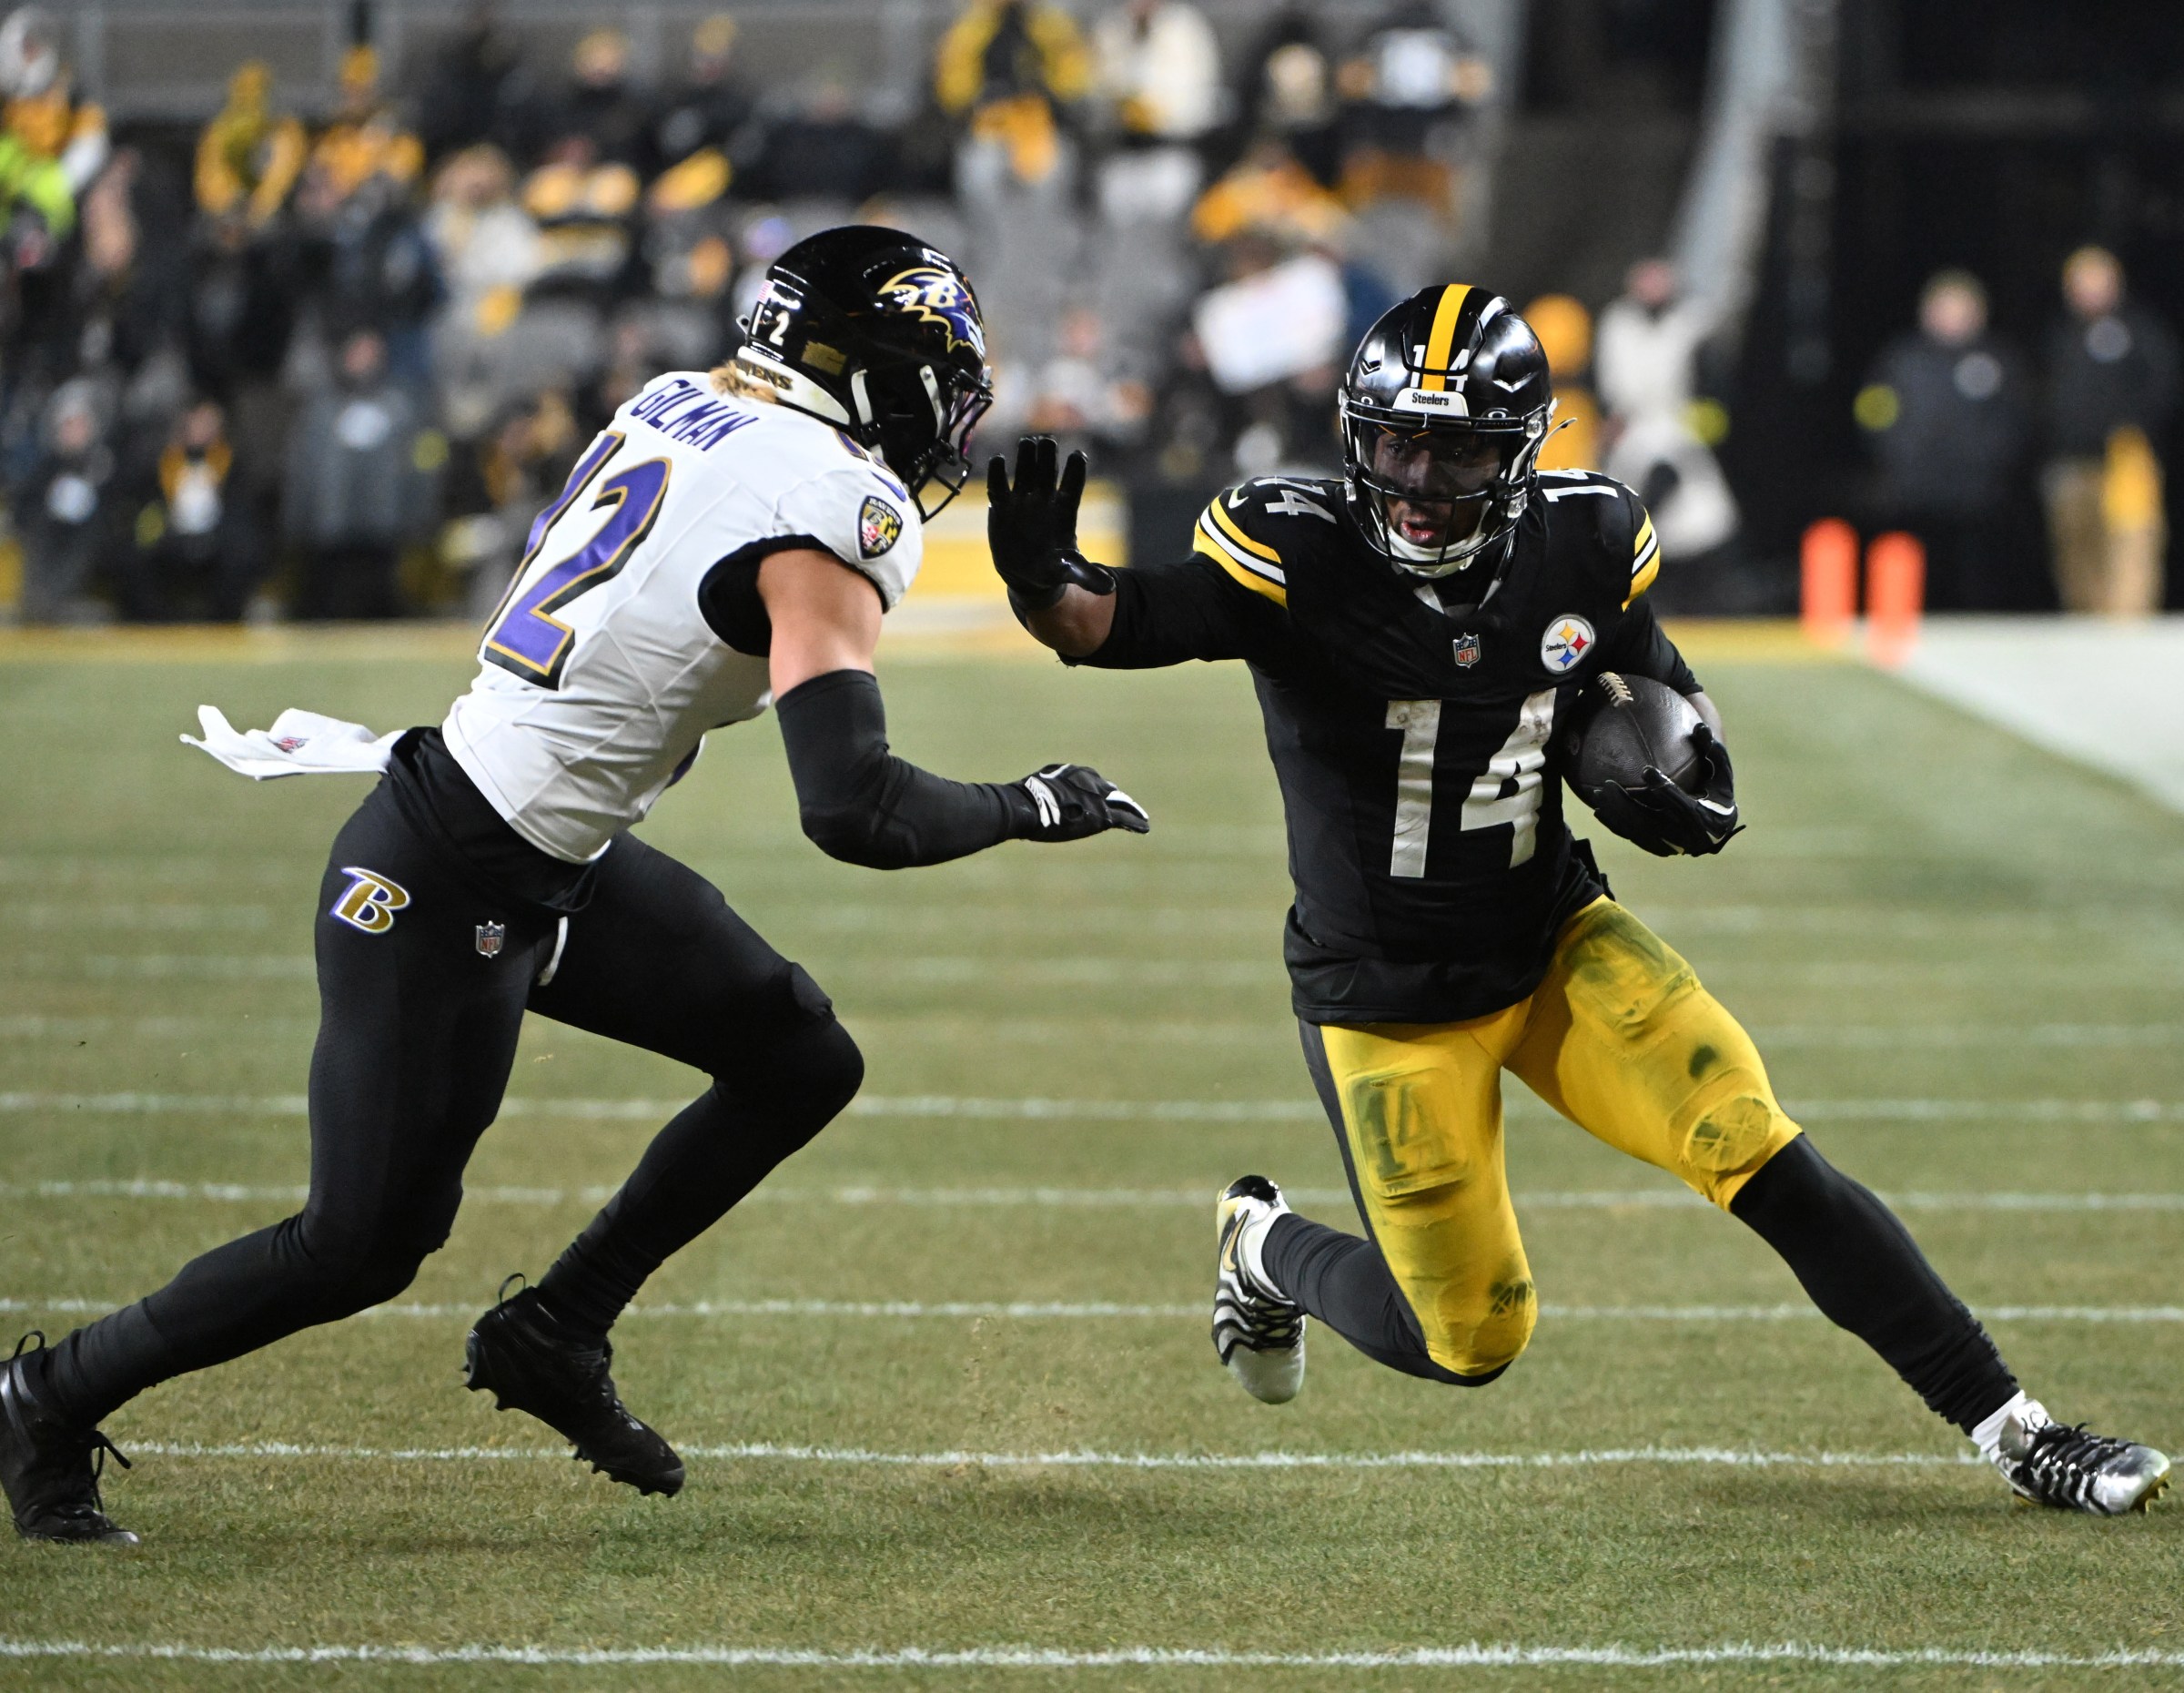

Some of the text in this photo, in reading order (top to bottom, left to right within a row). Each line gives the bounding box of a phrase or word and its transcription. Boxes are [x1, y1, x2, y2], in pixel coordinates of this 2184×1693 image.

[922, 277, 958, 309] B
[752, 303, 790, 346] 12
[737, 358, 794, 390] VENS
[1410, 344, 1470, 392] 14
[630, 379, 760, 452] GILMAN
[1411, 392, 1450, 406] Steelers
[868, 496, 902, 526] RAVENS
[1253, 478, 1338, 524] 14
[479, 430, 673, 692] 12
[1458, 649, 1477, 662] NFL
[1545, 643, 1567, 653] Steelers
[1384, 687, 1557, 878] 14
[329, 866, 413, 935] B
[480, 938, 500, 951] NFL
